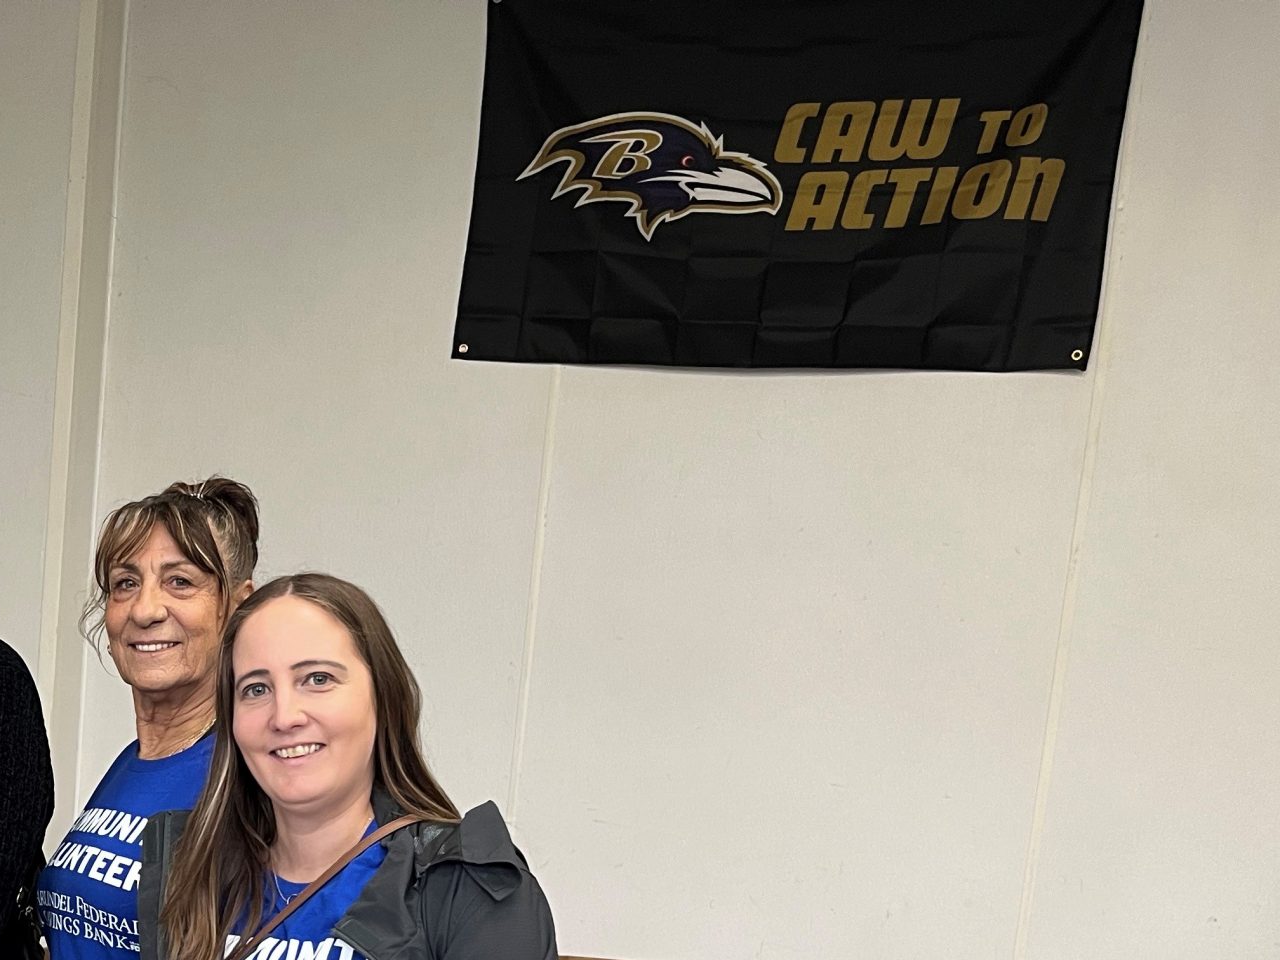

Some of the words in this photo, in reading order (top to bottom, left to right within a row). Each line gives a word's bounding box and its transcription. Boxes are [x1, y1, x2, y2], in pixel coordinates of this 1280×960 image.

[774, 98, 961, 164] CAW
[978, 103, 1048, 156] TO
[784, 156, 1066, 233] ACTION
[83, 922, 131, 950] BANK
